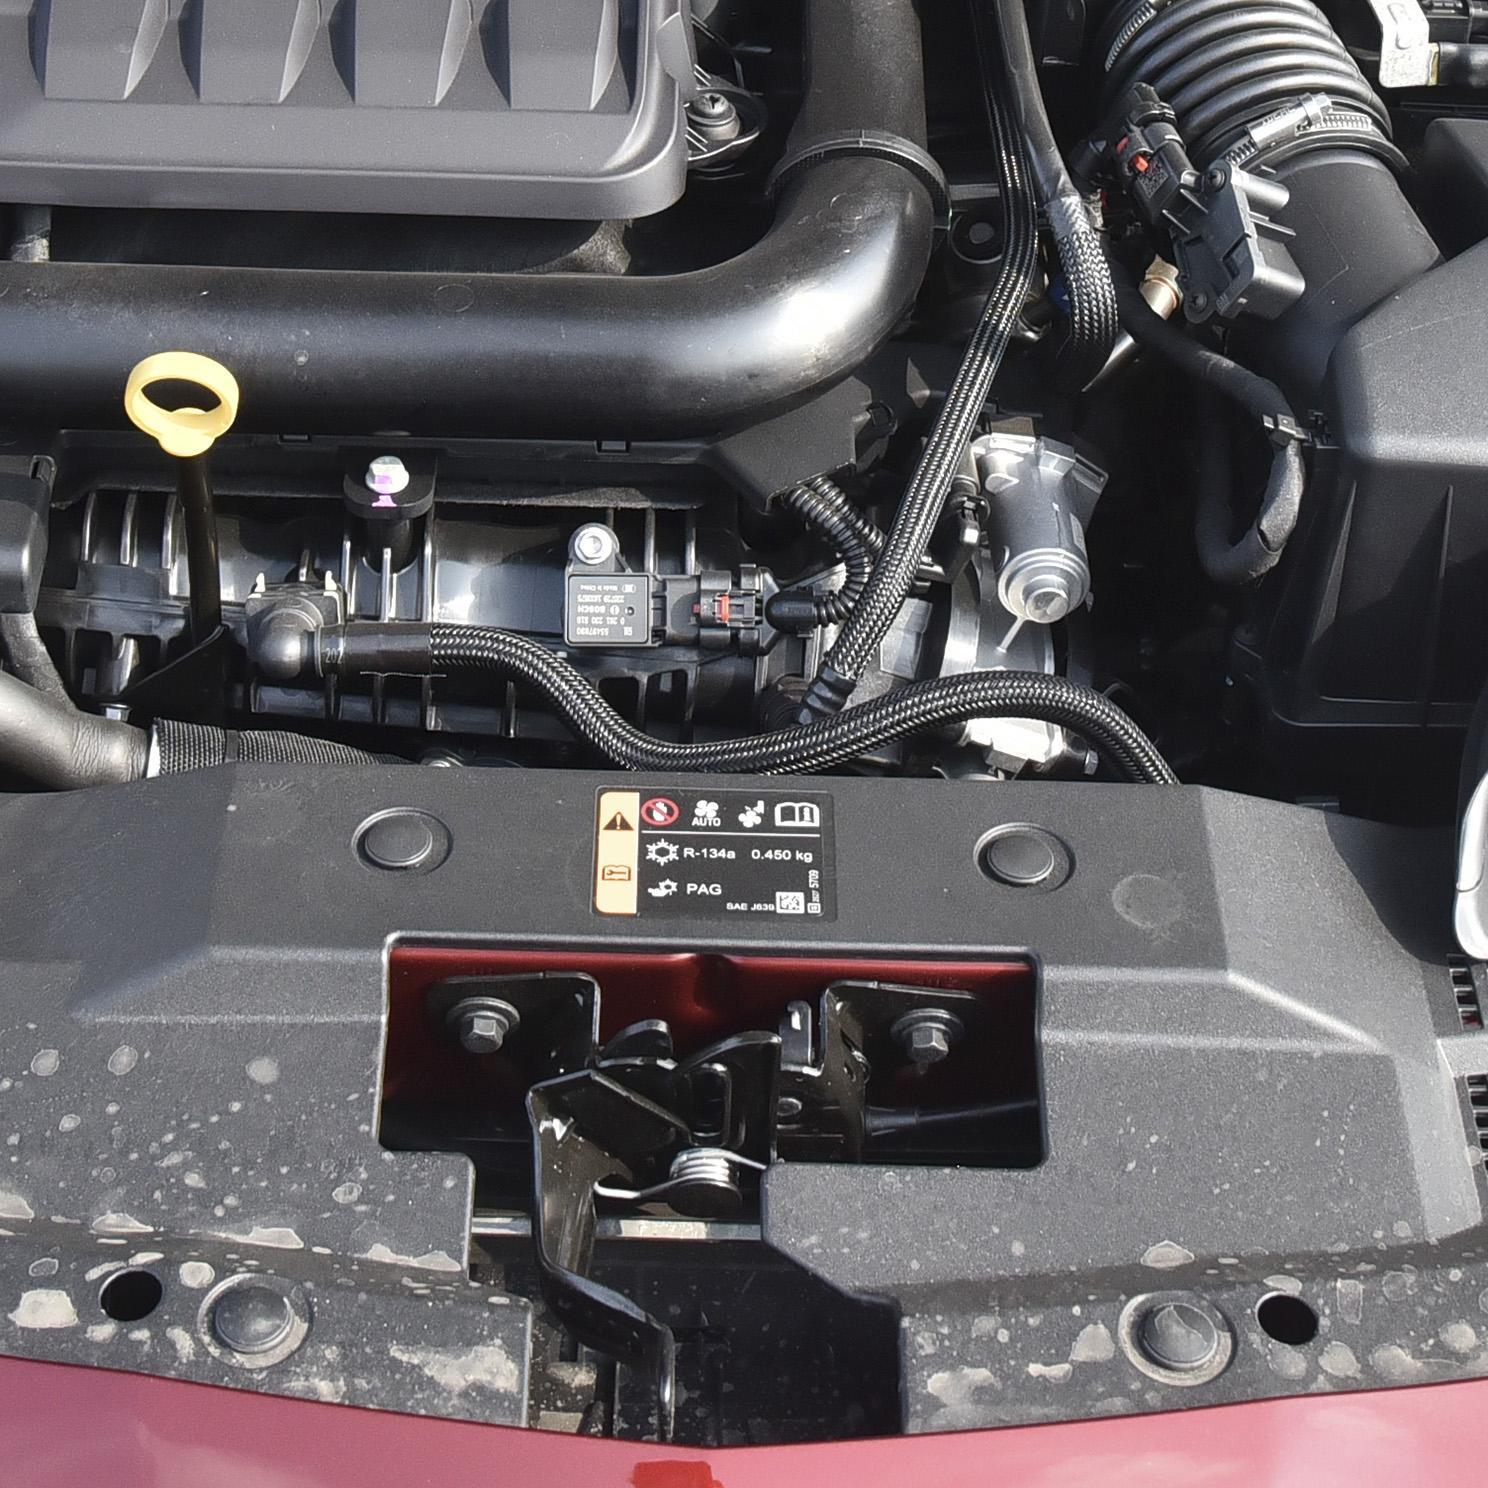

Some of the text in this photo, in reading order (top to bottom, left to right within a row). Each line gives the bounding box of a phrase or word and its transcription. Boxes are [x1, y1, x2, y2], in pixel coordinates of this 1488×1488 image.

[691, 817, 721, 827] AUTO
[683, 847, 813, 863] R-134a 0.450 kg
[686, 883, 722, 896] PAG
[726, 902, 748, 911] SAE
